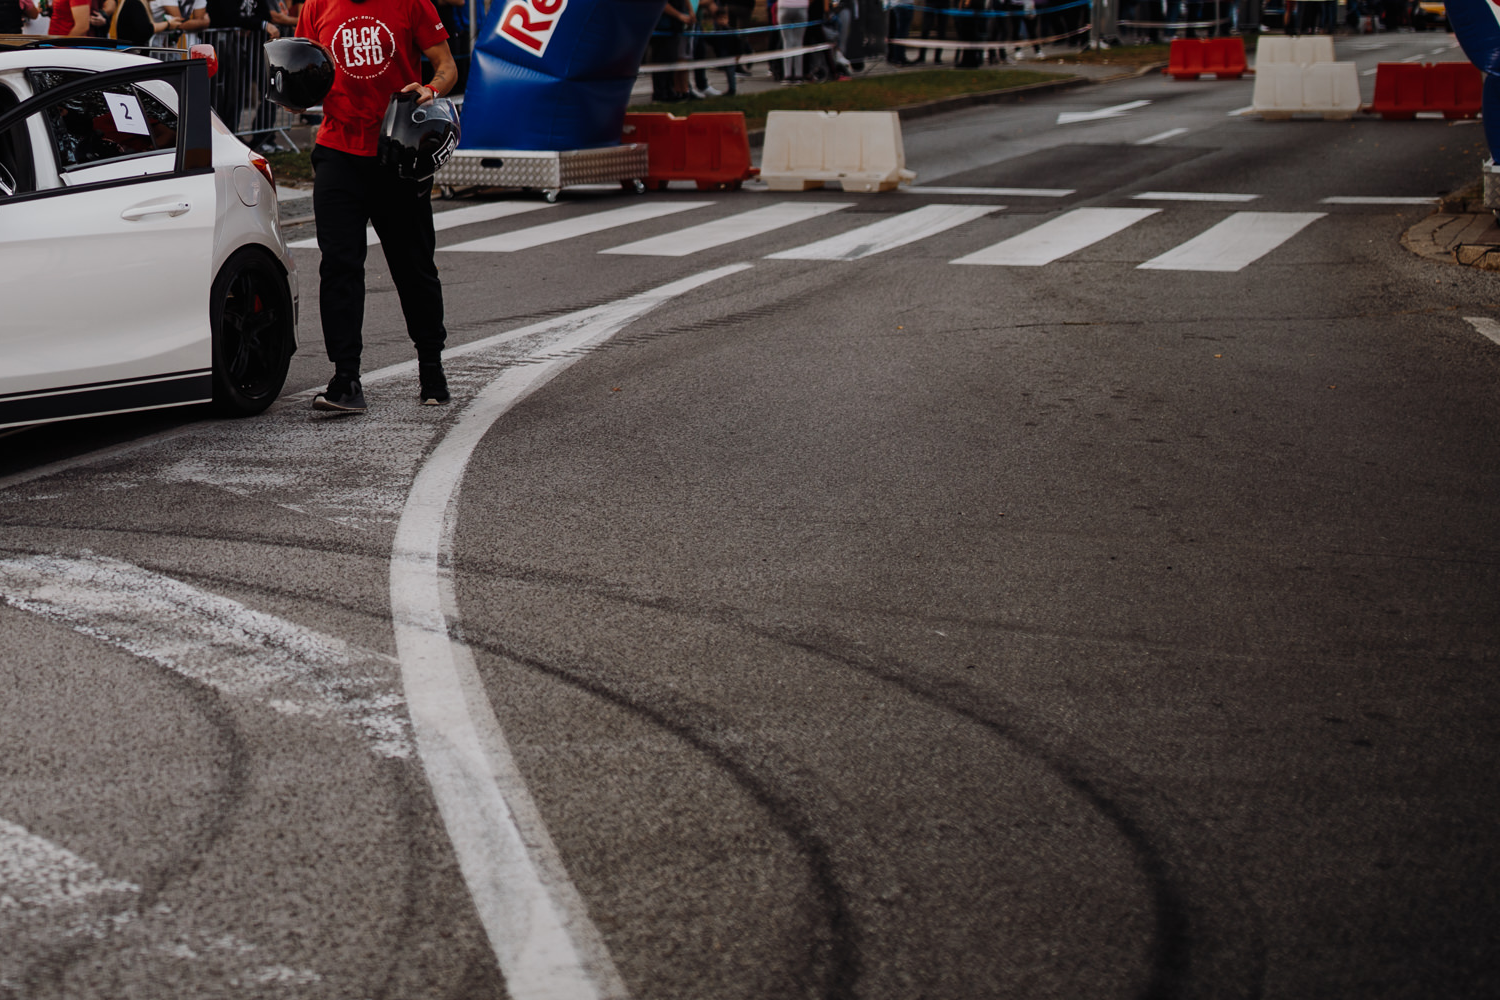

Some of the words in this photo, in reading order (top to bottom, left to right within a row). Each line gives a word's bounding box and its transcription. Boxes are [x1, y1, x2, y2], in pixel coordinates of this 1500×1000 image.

[342, 26, 382, 48] BLCK
[344, 45, 383, 68] LSTD
[119, 102, 133, 120] 2
